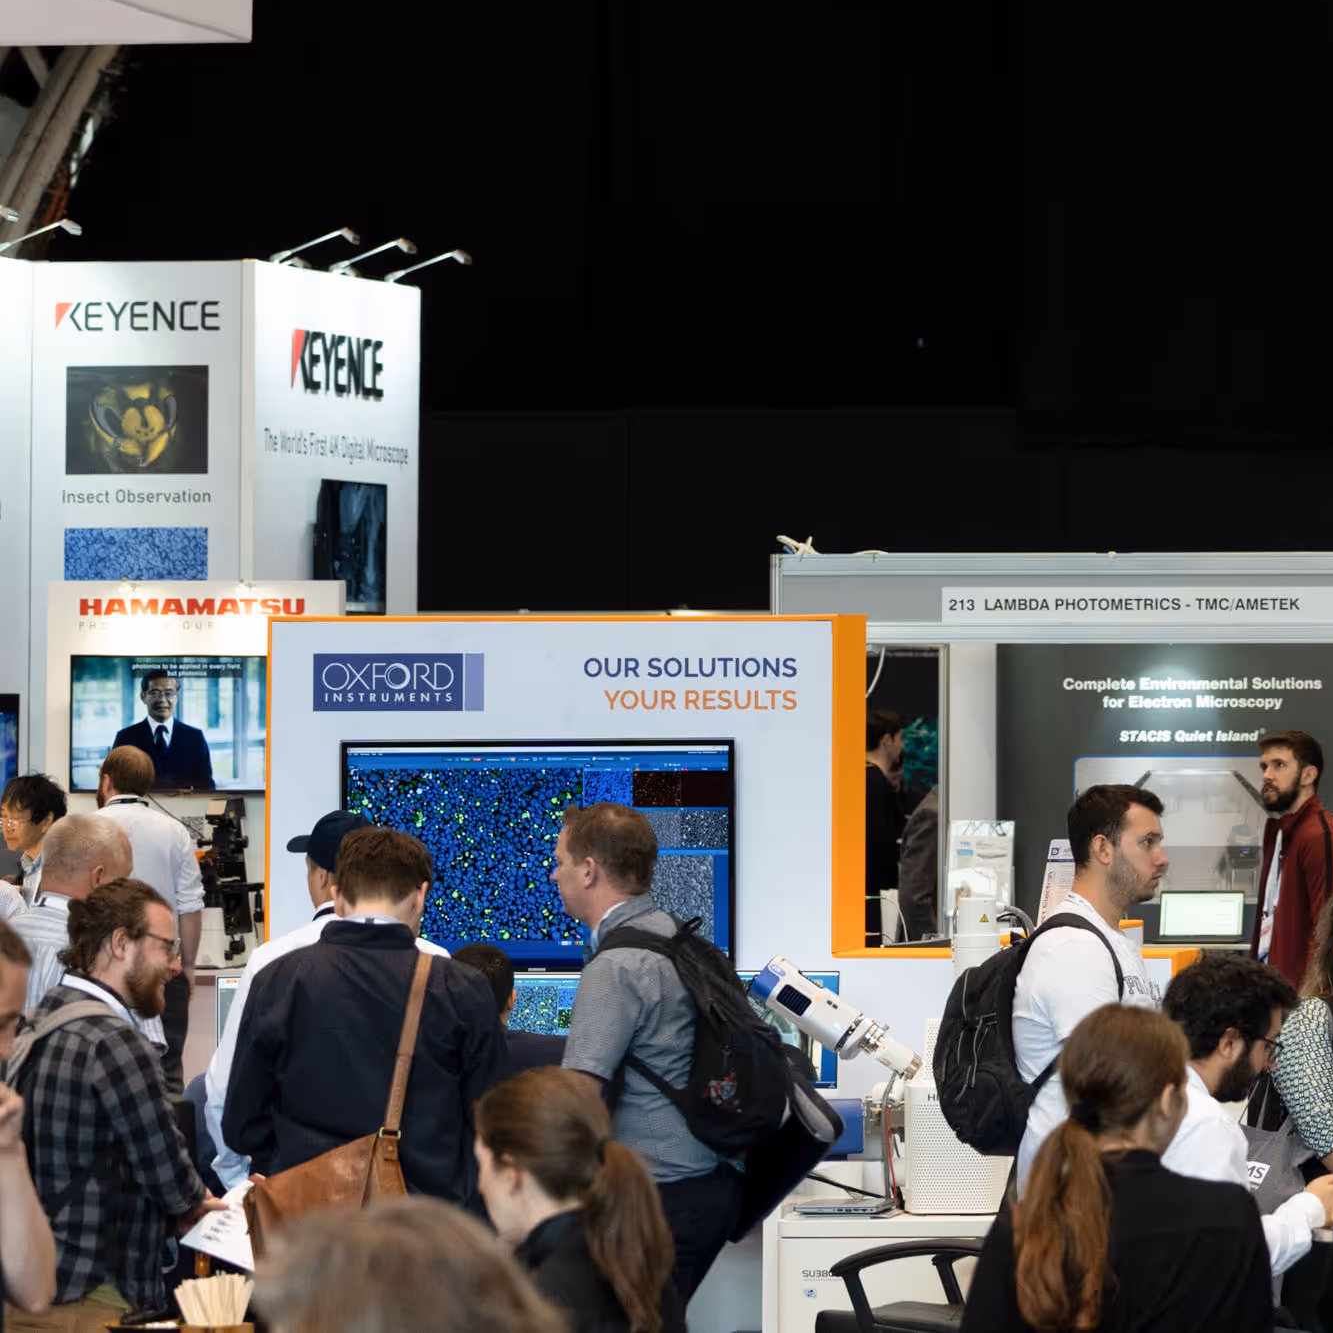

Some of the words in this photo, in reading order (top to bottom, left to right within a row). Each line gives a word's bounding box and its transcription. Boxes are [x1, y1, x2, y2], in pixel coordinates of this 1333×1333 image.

[55, 301, 220, 332] KEYENCE
[291, 329, 384, 402] KEYENCE
[62, 489, 110, 504] Insect
[115, 488, 212, 504] Observation
[79, 598, 305, 616] HAMAMATSU
[948, 598, 975, 611] 213
[984, 598, 1050, 611] LAMBDA
[1055, 597, 1181, 611] PHOTOMETRICS
[1195, 597, 1301, 612] TMC/AMETEK
[583, 657, 640, 678] OUR
[647, 657, 798, 678] SOLUTIONS
[321, 662, 455, 691] OXFORD
[1063, 677, 1135, 693] Complete
[1139, 677, 1248, 691] Environmental
[1252, 676, 1322, 691] Solutions
[324, 692, 454, 703] INSTRUMENTS
[604, 690, 676, 711] YOUR
[683, 689, 798, 711] RESULTS
[1103, 695, 1125, 709] for
[1128, 695, 1192, 709] Electron
[1196, 694, 1283, 711] Microscopy
[1119, 729, 1172, 743] STACIS
[1174, 729, 1214, 743] Quiet
